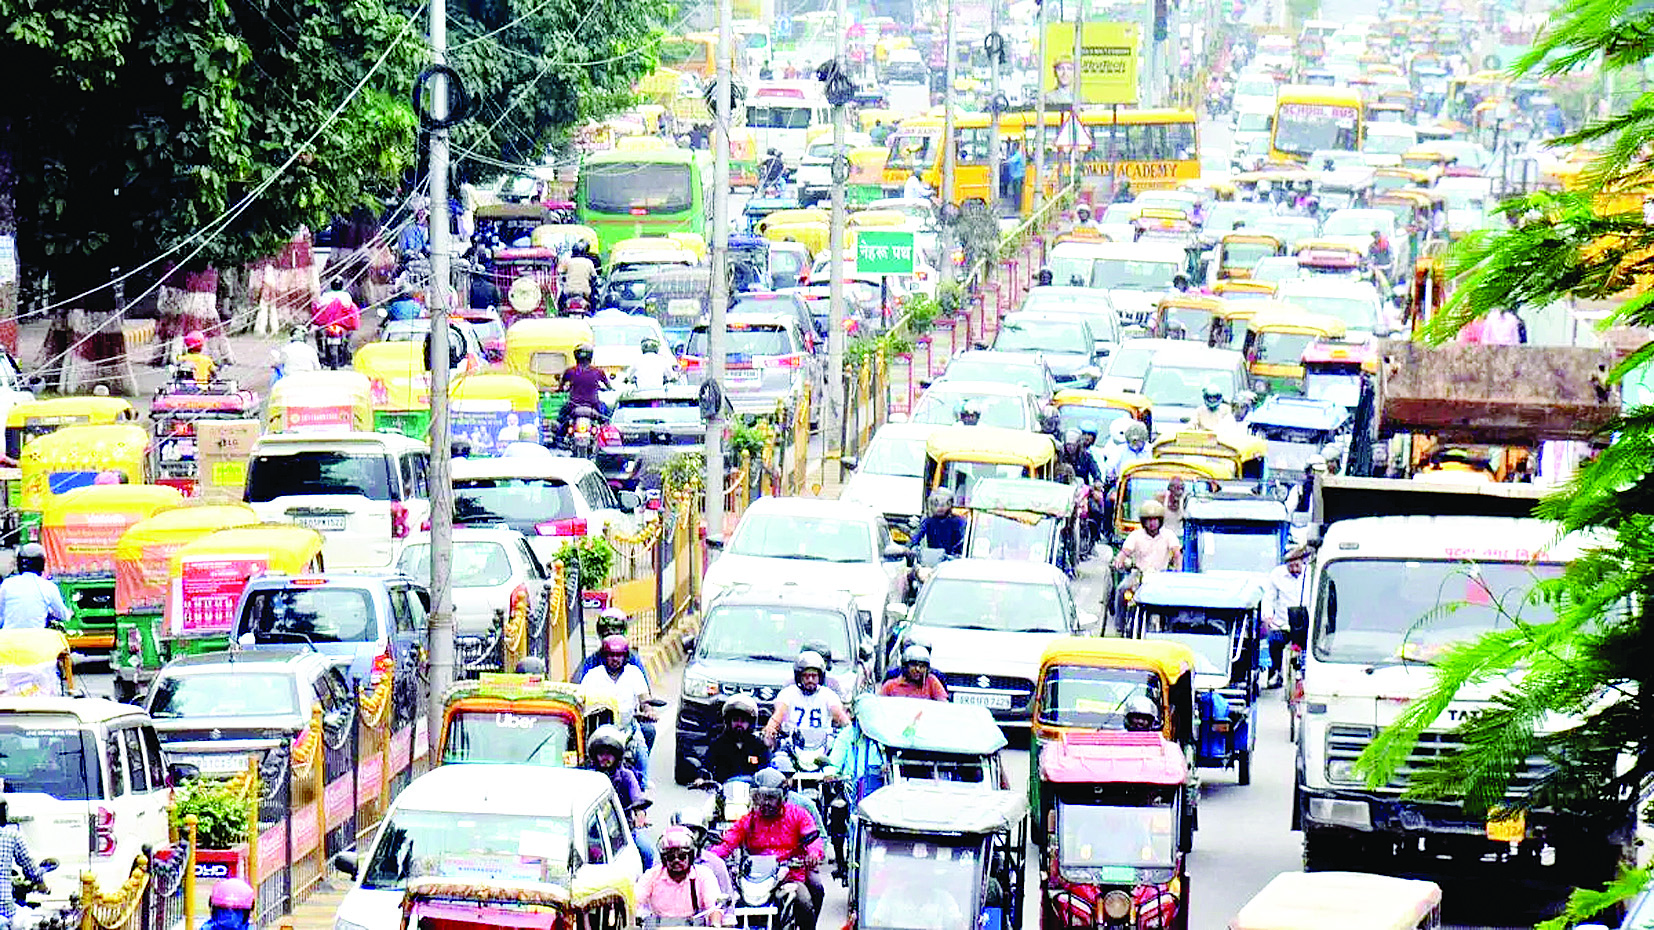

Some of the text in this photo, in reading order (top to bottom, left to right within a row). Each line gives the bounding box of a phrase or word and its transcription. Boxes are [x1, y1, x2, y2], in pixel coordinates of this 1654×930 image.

[1331, 108, 1355, 119] BUS
[1117, 163, 1178, 178] ACADEMY
[859, 239, 911, 261] नेहरू पथ
[496, 712, 537, 729] Uber
